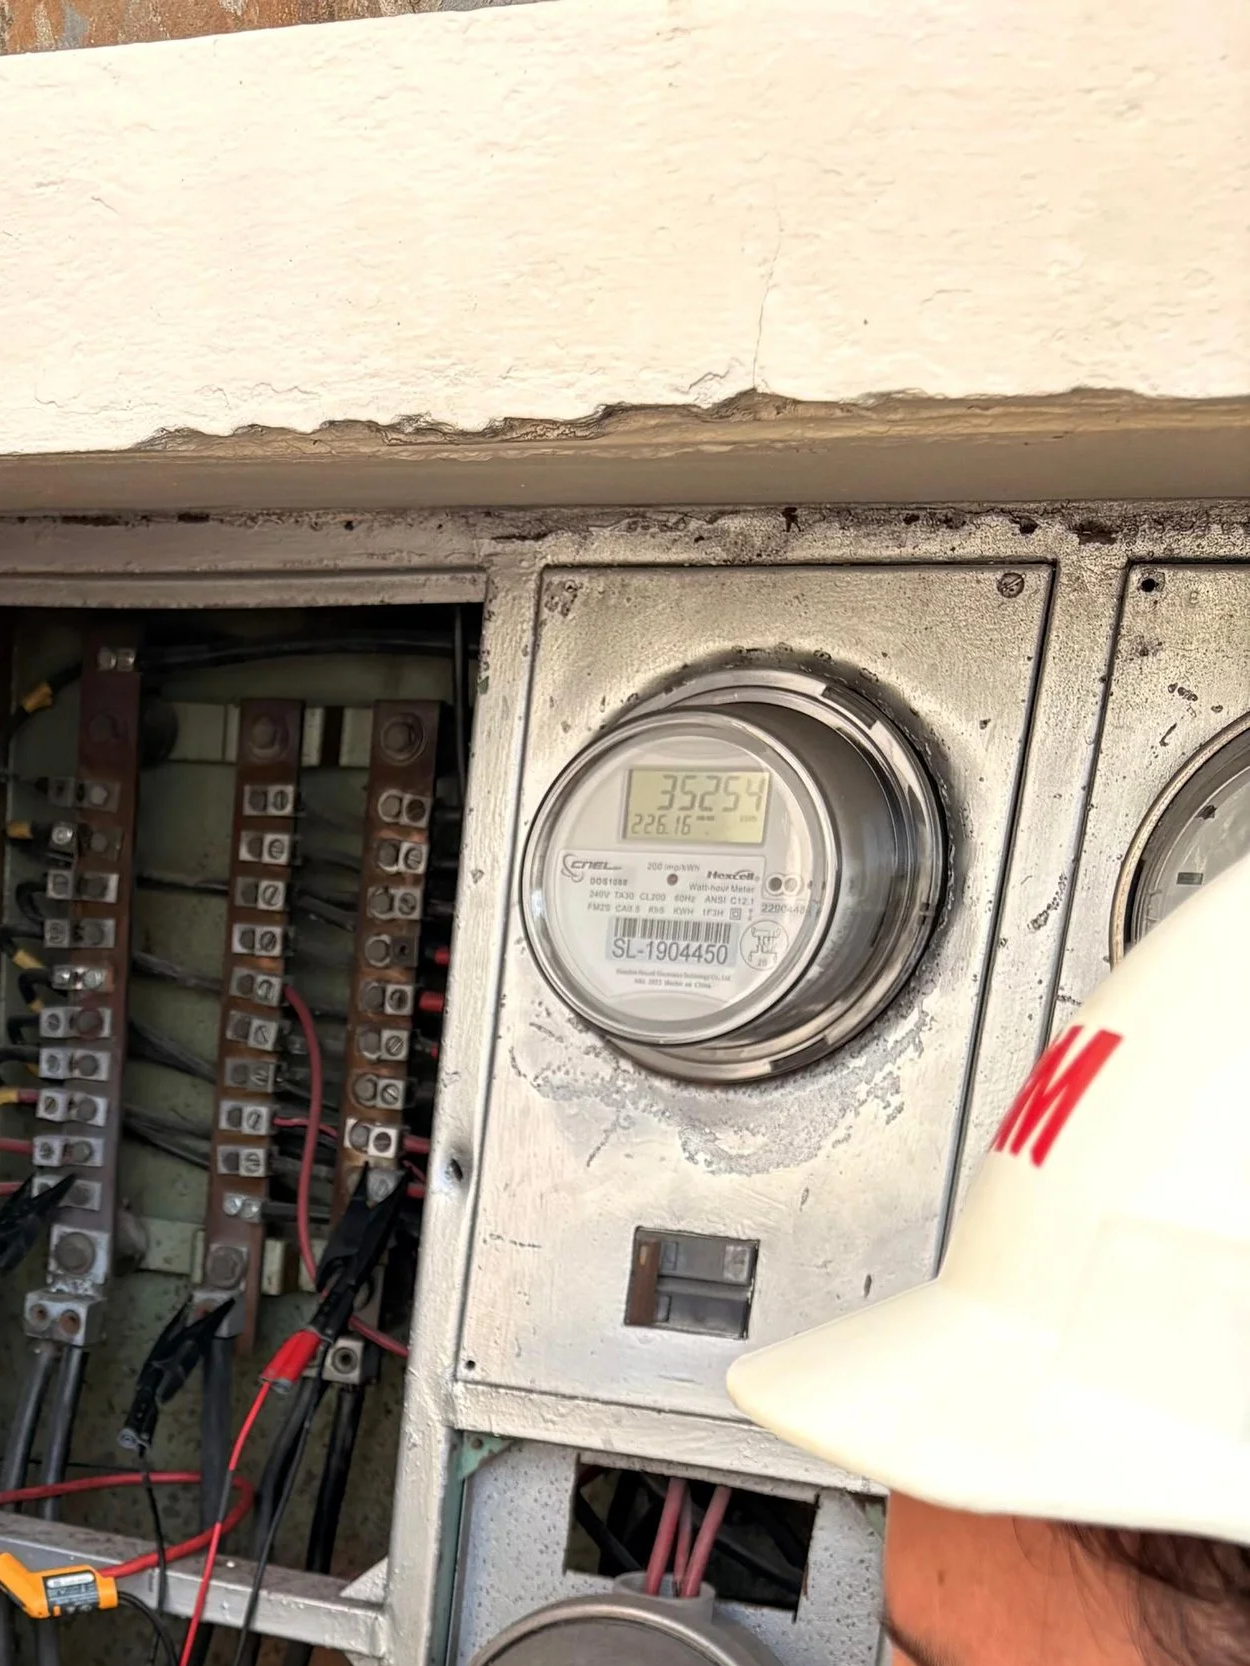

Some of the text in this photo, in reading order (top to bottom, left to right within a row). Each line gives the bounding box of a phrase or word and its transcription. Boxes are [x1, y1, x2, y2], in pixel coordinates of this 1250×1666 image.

[657, 774, 766, 812] 35254
[731, 885, 755, 894] Meter
[704, 895, 726, 904] ANSI
[612, 938, 728, 965] SL-1904450
